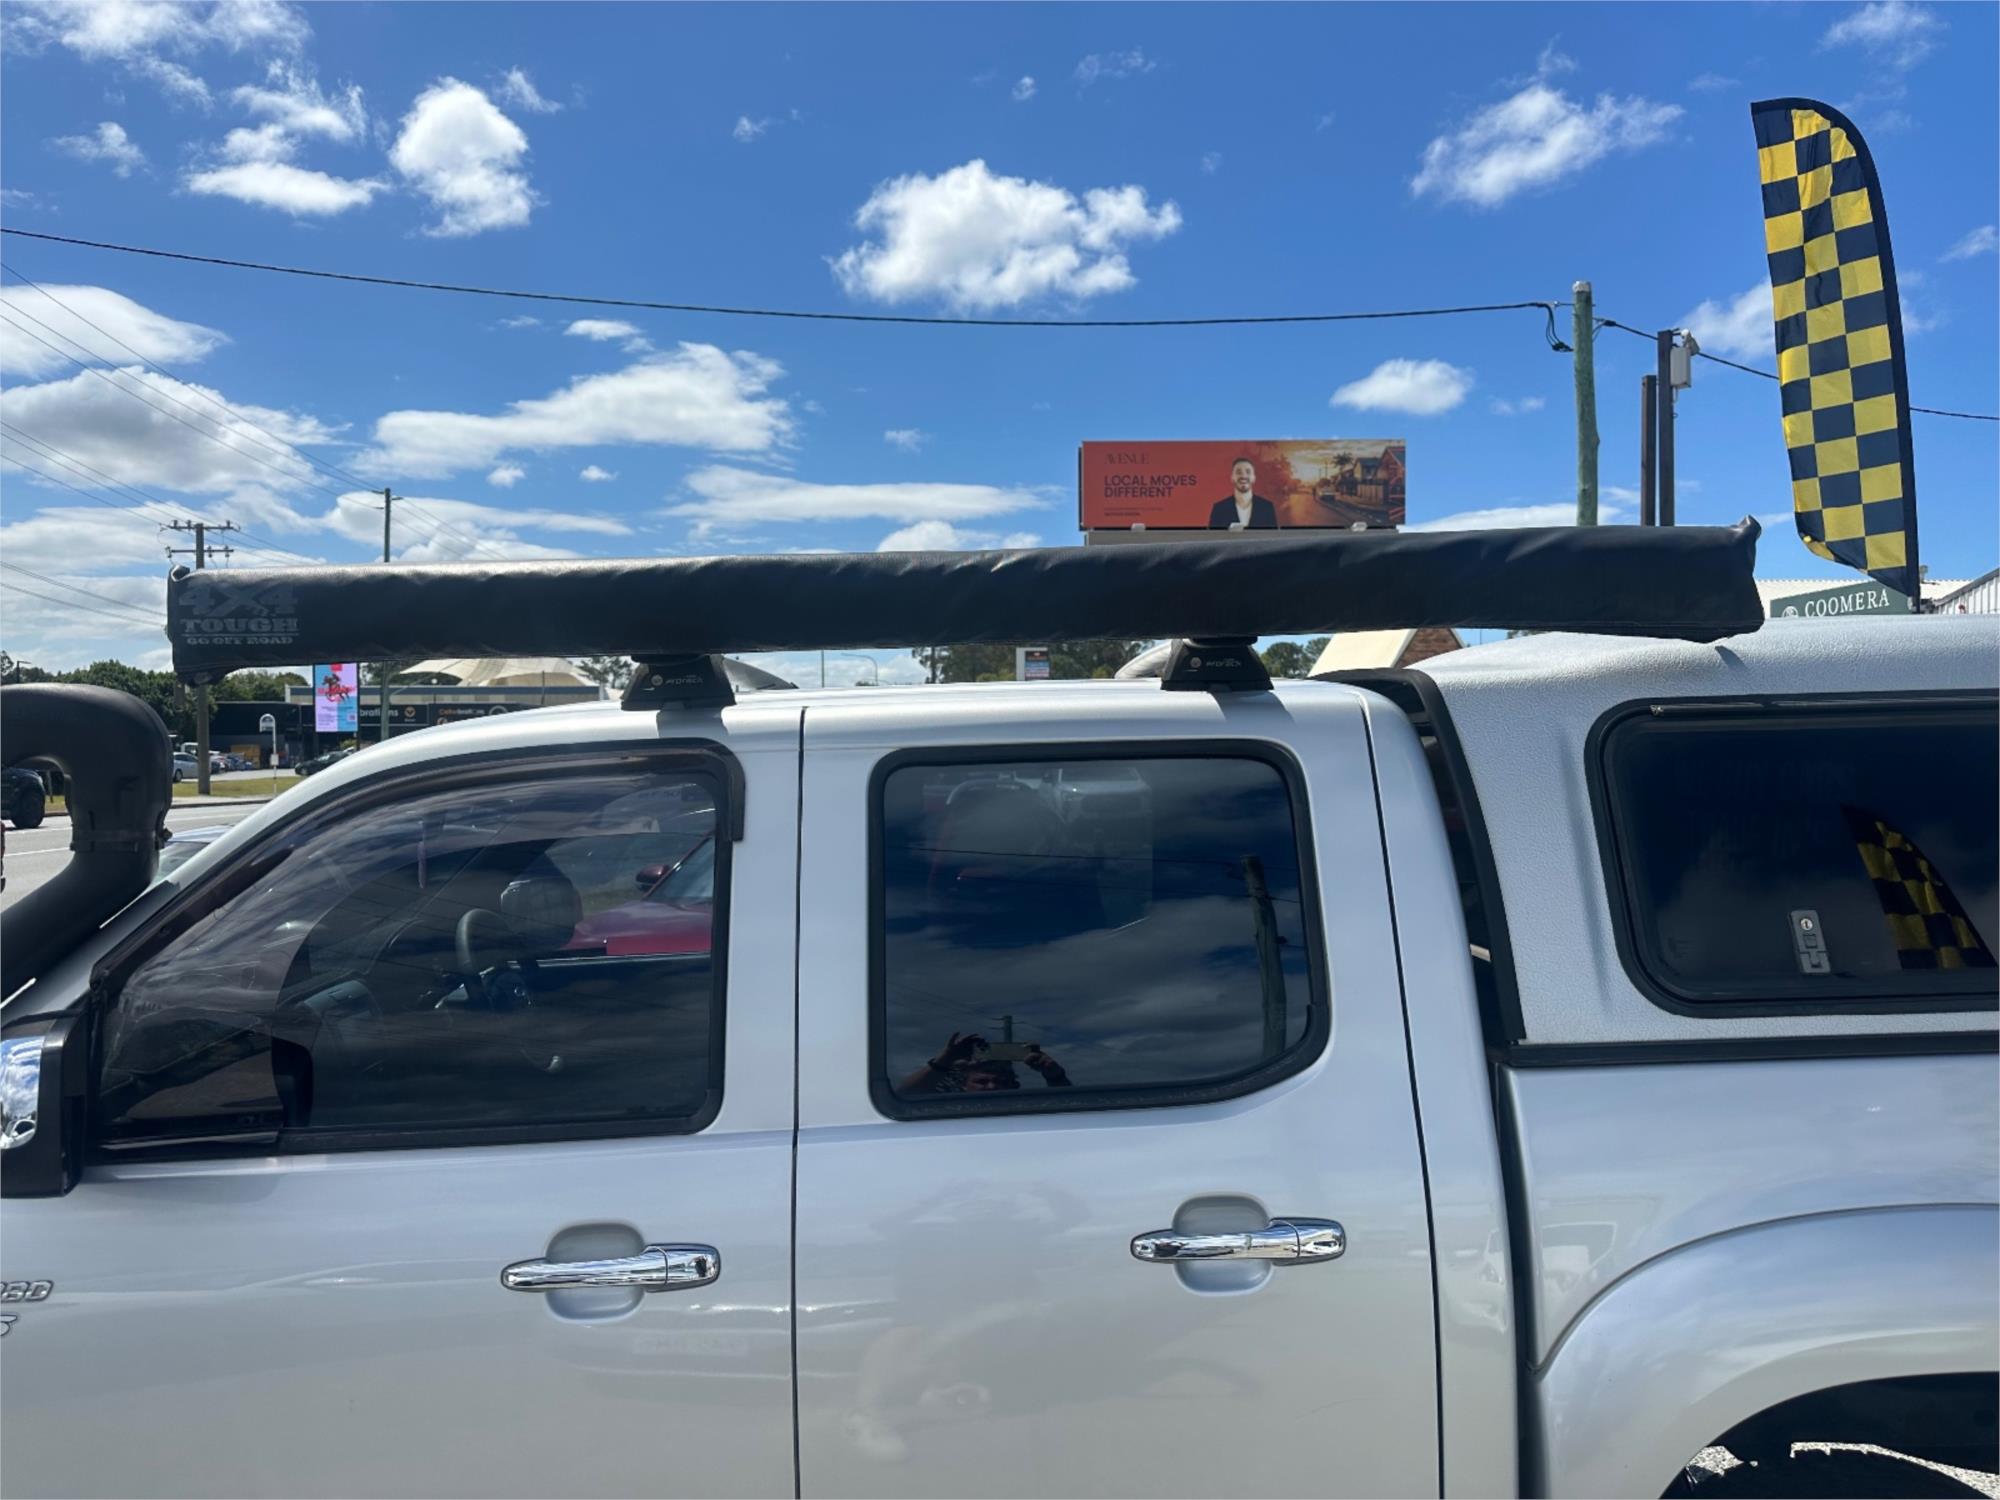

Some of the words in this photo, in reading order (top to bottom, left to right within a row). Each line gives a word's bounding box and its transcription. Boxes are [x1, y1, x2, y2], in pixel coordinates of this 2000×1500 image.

[1104, 475, 1147, 486] LOCAL
[1150, 475, 1197, 486] MOVES
[1104, 487, 1174, 498] DIFFERENT
[1804, 588, 1890, 617] COOMERA
[181, 618, 299, 633] TOUGH
[186, 637, 210, 645] GO
[247, 637, 293, 645] ROAD
